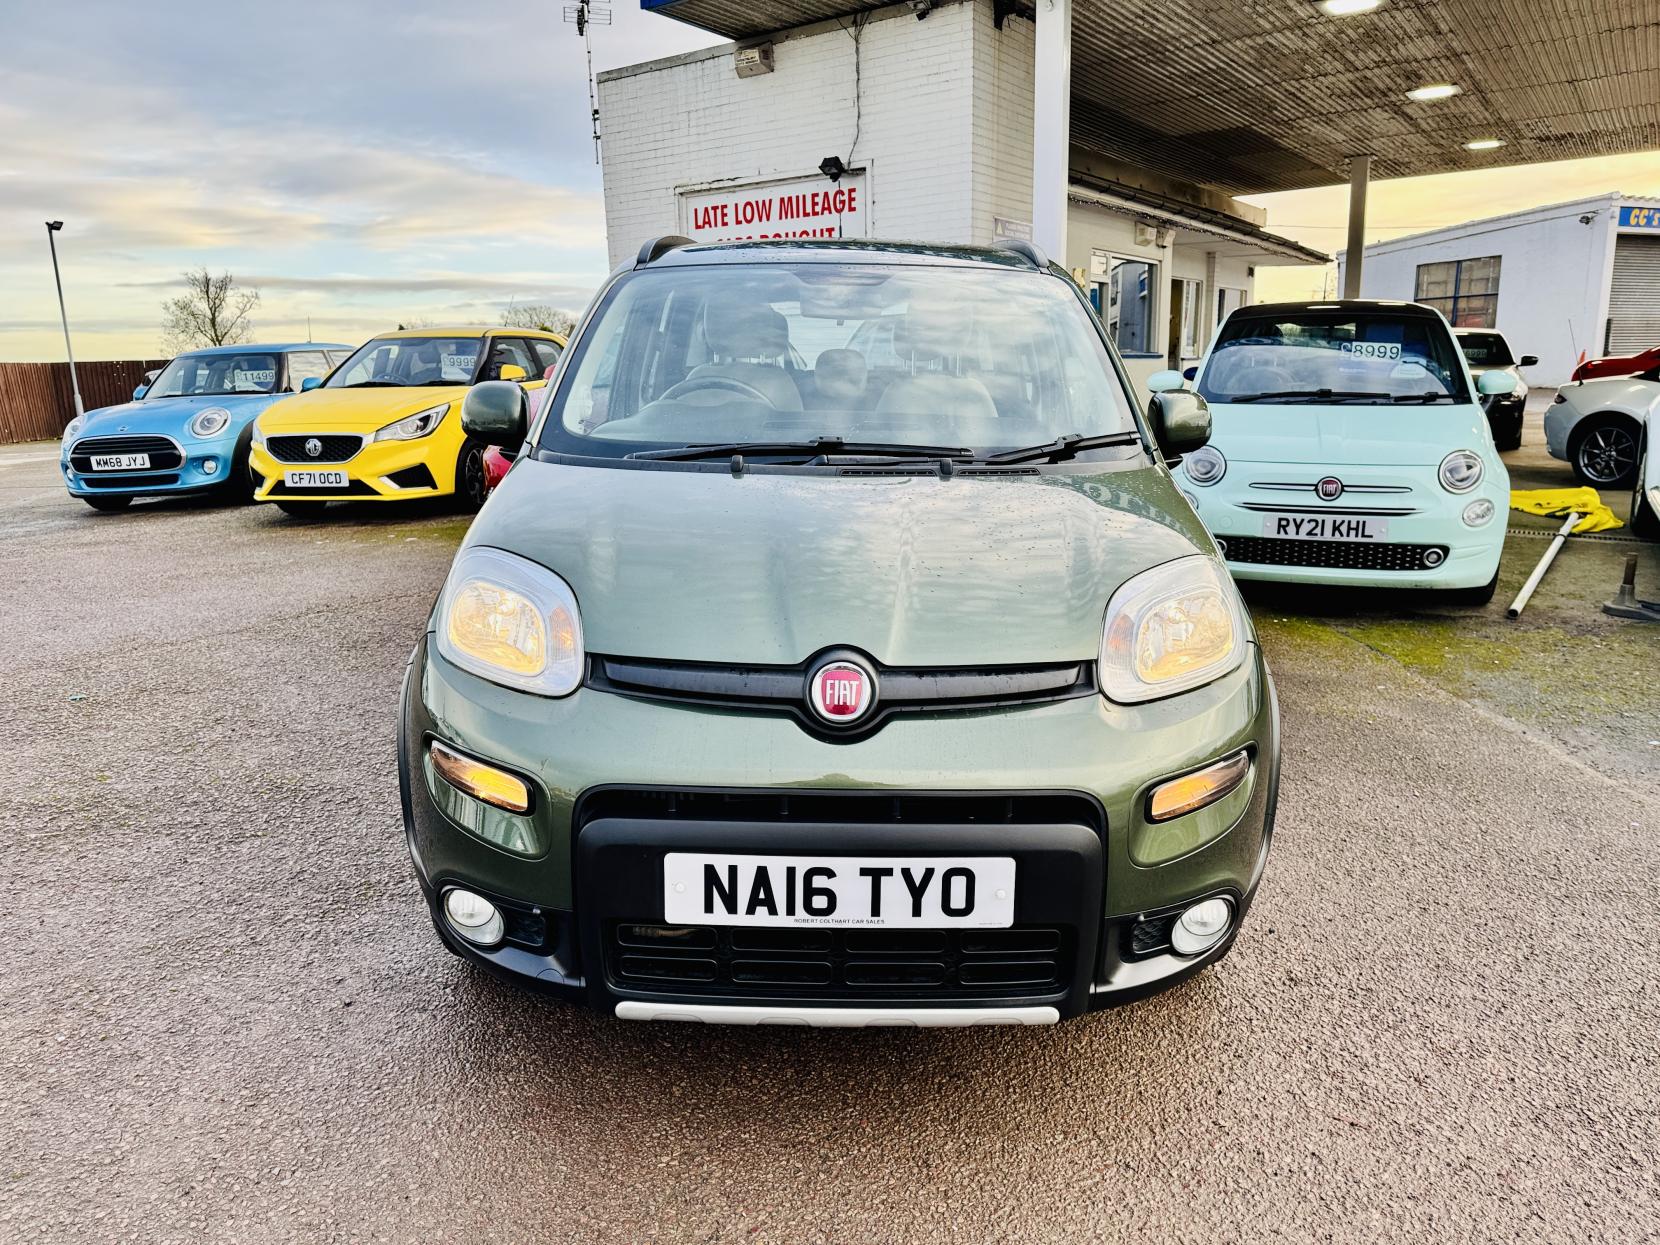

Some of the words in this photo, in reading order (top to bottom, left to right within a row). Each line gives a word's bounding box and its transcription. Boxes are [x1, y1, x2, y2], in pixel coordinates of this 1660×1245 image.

[694, 204, 729, 230] LATE
[734, 198, 773, 225] LOW
[778, 187, 857, 220] MILEAGE
[95, 457, 122, 468] MM68
[126, 455, 146, 467] JYJ
[319, 472, 342, 484] OCD
[1323, 484, 1337, 494] FIAT
[1276, 517, 1325, 536] RY21
[1331, 519, 1374, 538] KHL
[825, 679, 859, 706] FIAT
[703, 863, 838, 917] NA16
[859, 867, 976, 918] TYO
